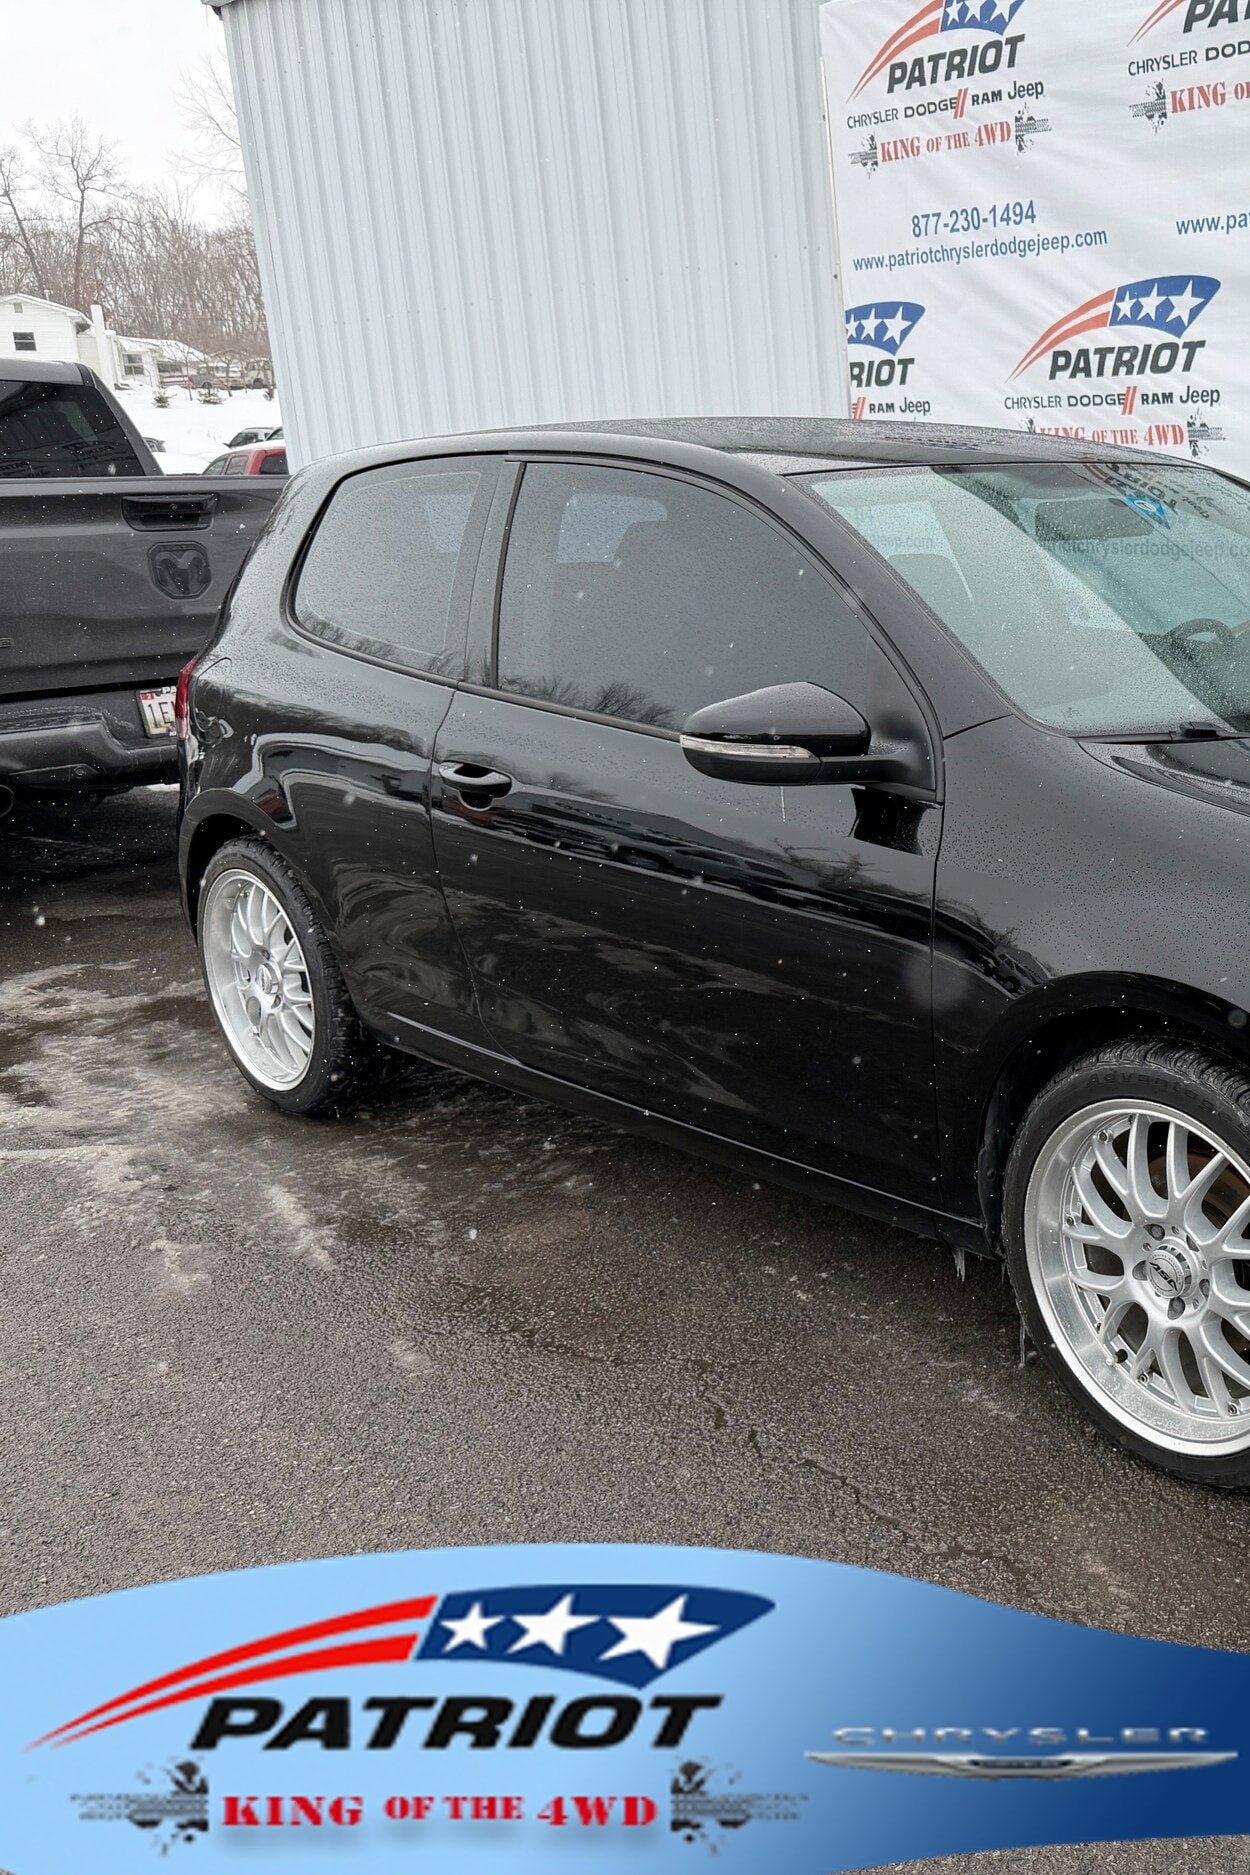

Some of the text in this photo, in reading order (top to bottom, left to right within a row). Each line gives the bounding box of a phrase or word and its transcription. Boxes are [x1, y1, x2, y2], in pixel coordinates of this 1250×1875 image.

[887, 34, 1025, 93] PATRIOT
[1128, 50, 1198, 76] CHRYSLER
[847, 80, 1044, 128] CHRYSLER DODGE RAM Jeep
[1170, 82, 1227, 113] KING
[881, 121, 1011, 163] KING OF THE 4WD
[912, 200, 1037, 237] 877-230-1494
[853, 230, 1107, 270] www.patriotchryslerdodgejeep.com
[1048, 340, 1206, 380] PATRIOT
[869, 402, 895, 414] RAM
[899, 397, 931, 416] Jeep
[1004, 385, 1221, 410] CHRYSLER DODGE RAM Jeep
[1091, 430, 1107, 443] OF
[1111, 429, 1138, 444] THE
[1144, 424, 1185, 446] 4WD
